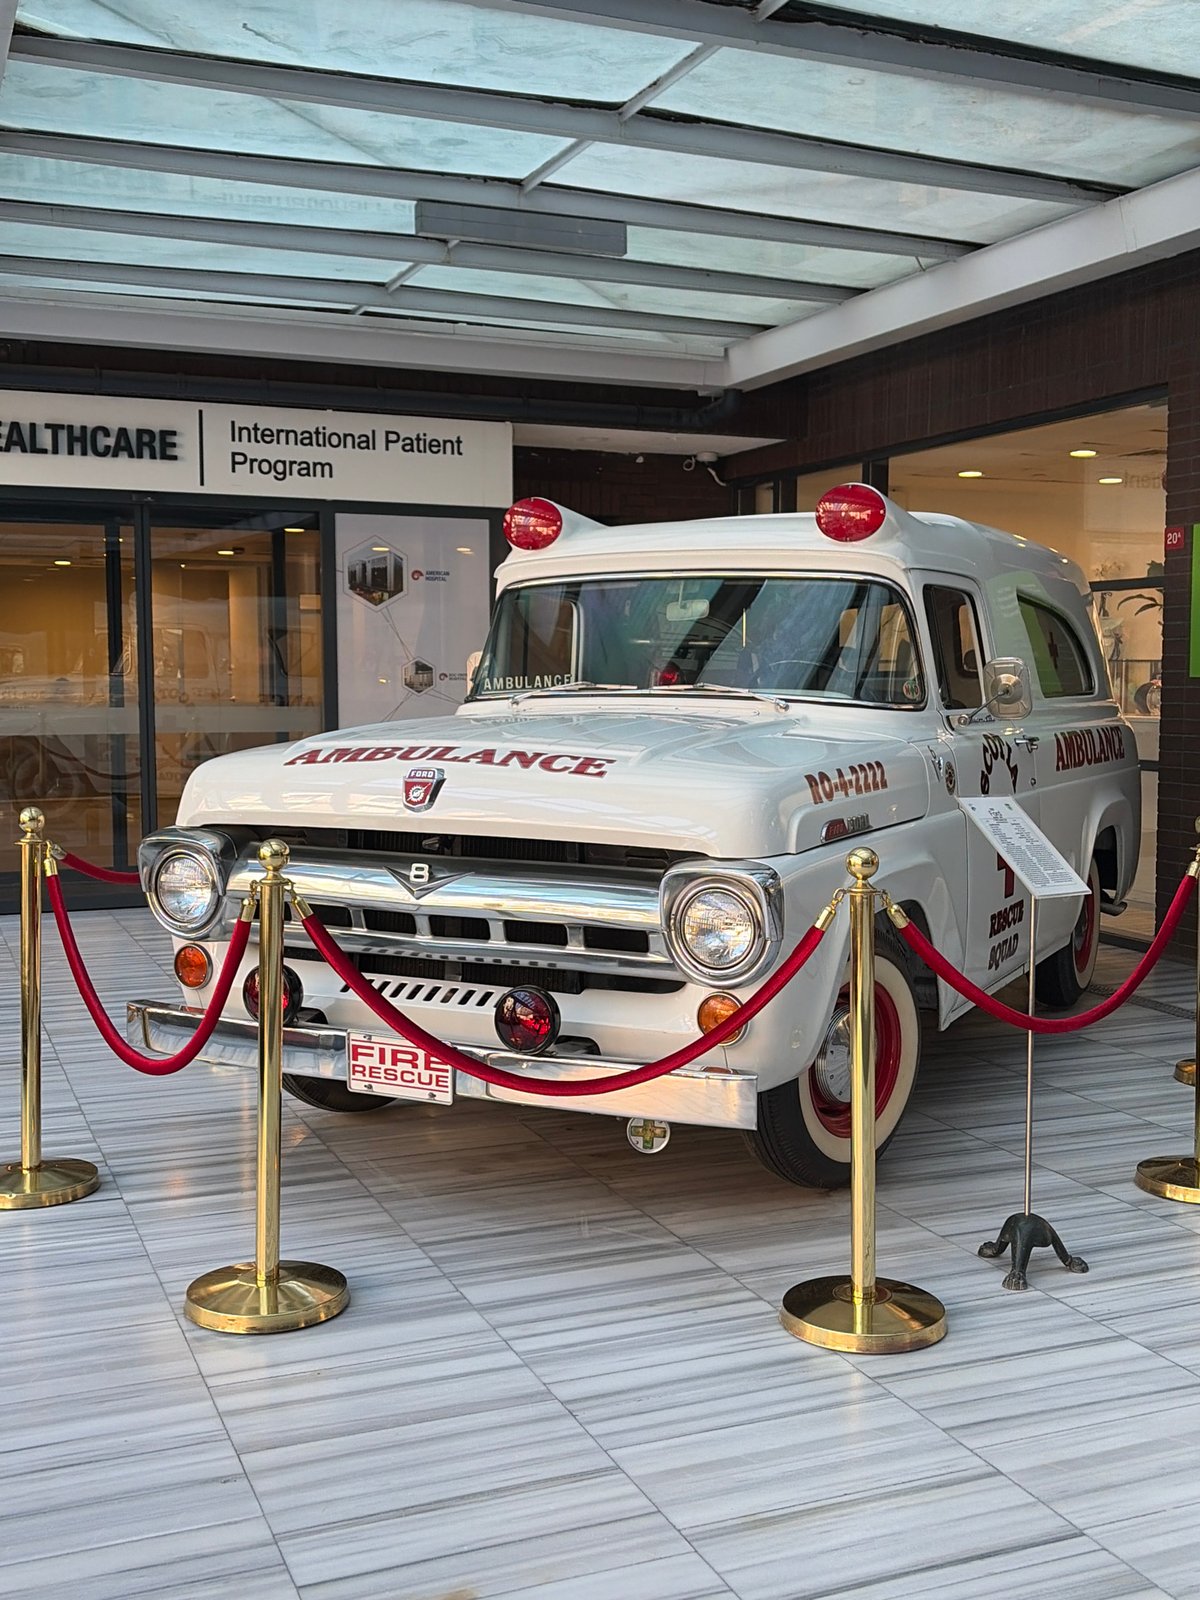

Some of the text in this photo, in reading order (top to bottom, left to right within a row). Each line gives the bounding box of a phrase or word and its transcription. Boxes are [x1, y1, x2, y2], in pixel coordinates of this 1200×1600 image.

[0, 420, 179, 461] ALTHCARE
[230, 420, 463, 456] International Patient
[230, 451, 334, 481] Program
[483, 674, 572, 690] AMBULANCE
[284, 746, 616, 779] AMBULANCE
[1054, 726, 1126, 772] AMBULANCE
[410, 770, 435, 779] FORD
[804, 760, 889, 805] RO-4-2222
[988, 899, 1025, 939] RESCUE
[987, 932, 1020, 972] SQUAD
[351, 1043, 449, 1073] FIRE
[351, 1063, 449, 1089] RESCUE
